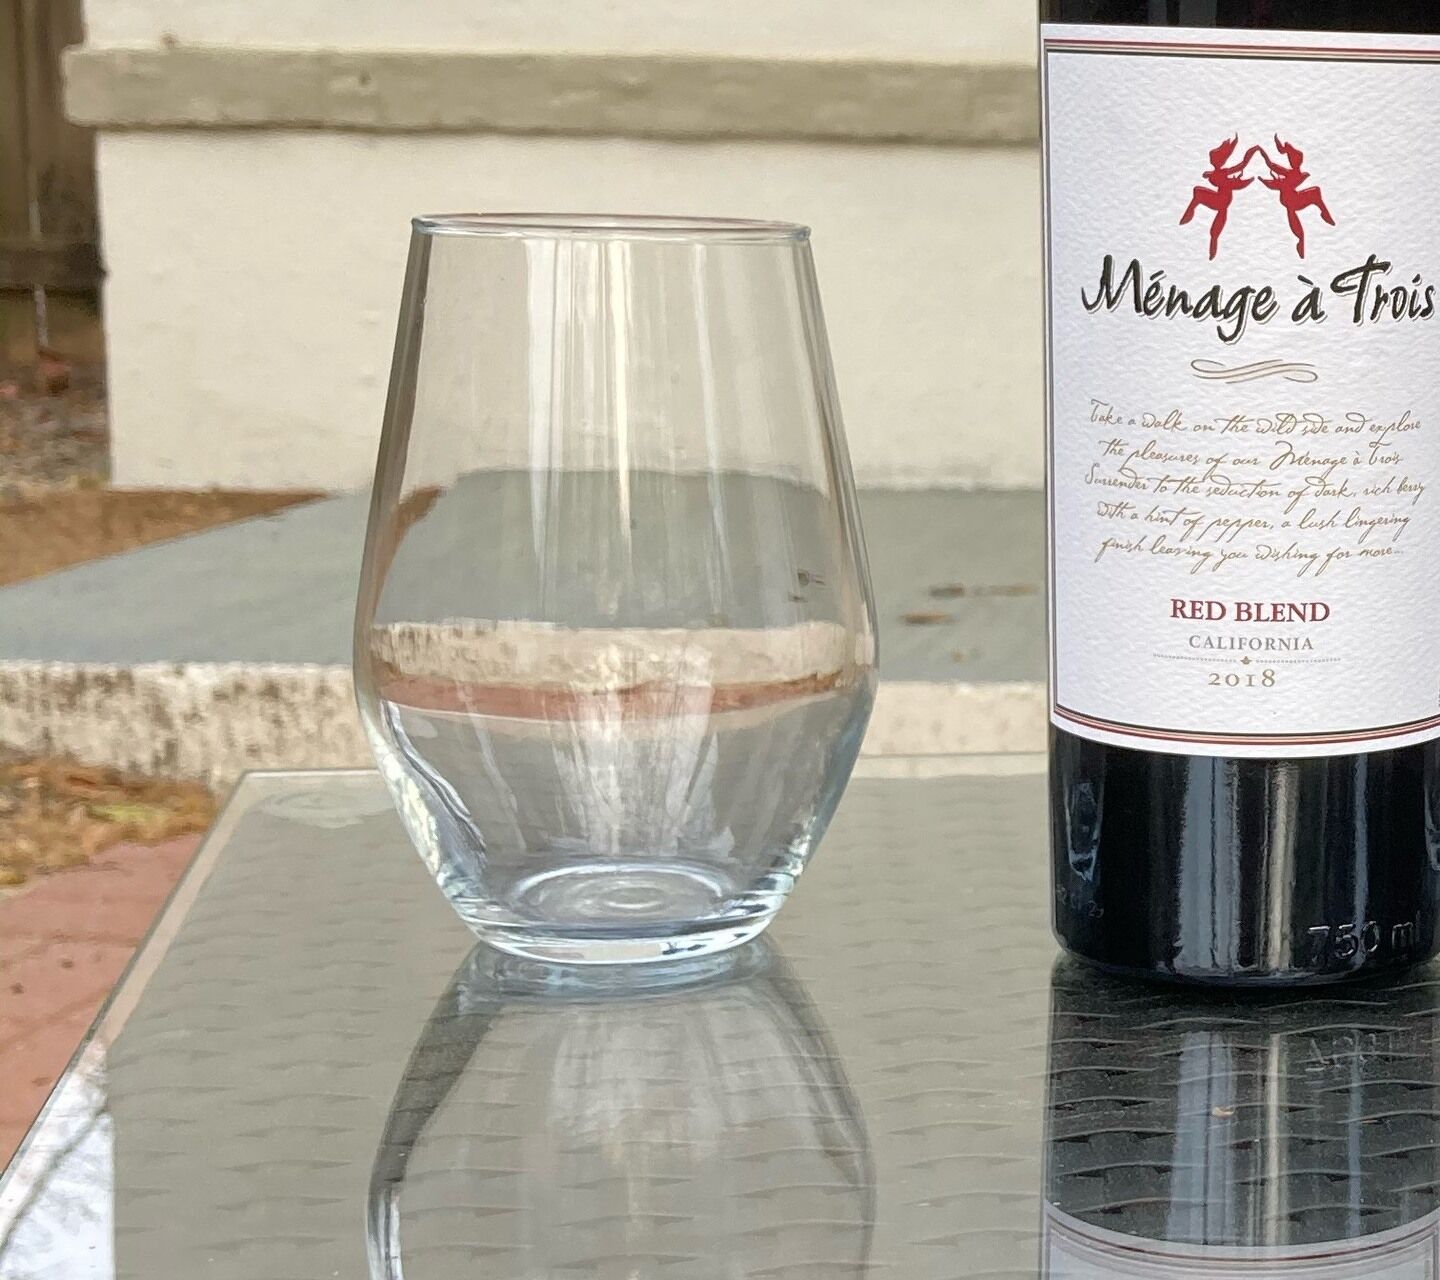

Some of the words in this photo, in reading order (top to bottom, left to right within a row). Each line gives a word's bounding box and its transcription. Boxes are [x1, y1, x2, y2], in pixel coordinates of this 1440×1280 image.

[1081, 254, 1280, 344] Ménage
[1292, 275, 1325, 326] à
[1330, 254, 1436, 327] Trois
[1091, 399, 1123, 425] Take
[1127, 417, 1137, 426] a
[1142, 409, 1188, 433] walk
[1193, 423, 1215, 433] on
[1214, 414, 1254, 434] the
[1256, 412, 1303, 435] wild
[1301, 412, 1332, 436] side
[1335, 411, 1373, 434] and
[1369, 410, 1421, 448] explore
[1098, 438, 1129, 457] the
[1119, 439, 1201, 472] pleasures
[1205, 452, 1229, 481] of
[1232, 457, 1261, 466] our
[1269, 440, 1348, 484] Ménage
[1352, 450, 1363, 466] à
[1085, 462, 1148, 491] Surrender
[1147, 474, 1172, 494] to
[1169, 475, 1204, 495] the
[1206, 474, 1282, 499] seduction
[1284, 485, 1312, 515] of
[1363, 475, 1397, 496] rich
[1397, 476, 1426, 506] berry
[1096, 500, 1136, 520] with
[1130, 511, 1139, 520] a
[1144, 504, 1202, 526] hint
[1178, 514, 1206, 543] of
[1298, 507, 1341, 530] lush
[1343, 506, 1411, 545] lingering
[1094, 535, 1147, 564] finish
[1149, 534, 1214, 575] leaving
[1212, 549, 1249, 573] you
[1254, 541, 1321, 578] wishing
[1314, 546, 1353, 577] for
[1169, 598, 1227, 621] RED
[1233, 601, 1331, 623] BLEND
[1188, 634, 1315, 652] CALIFORNIA
[1207, 668, 1276, 688] 2018
[1307, 920, 1380, 963] 750
